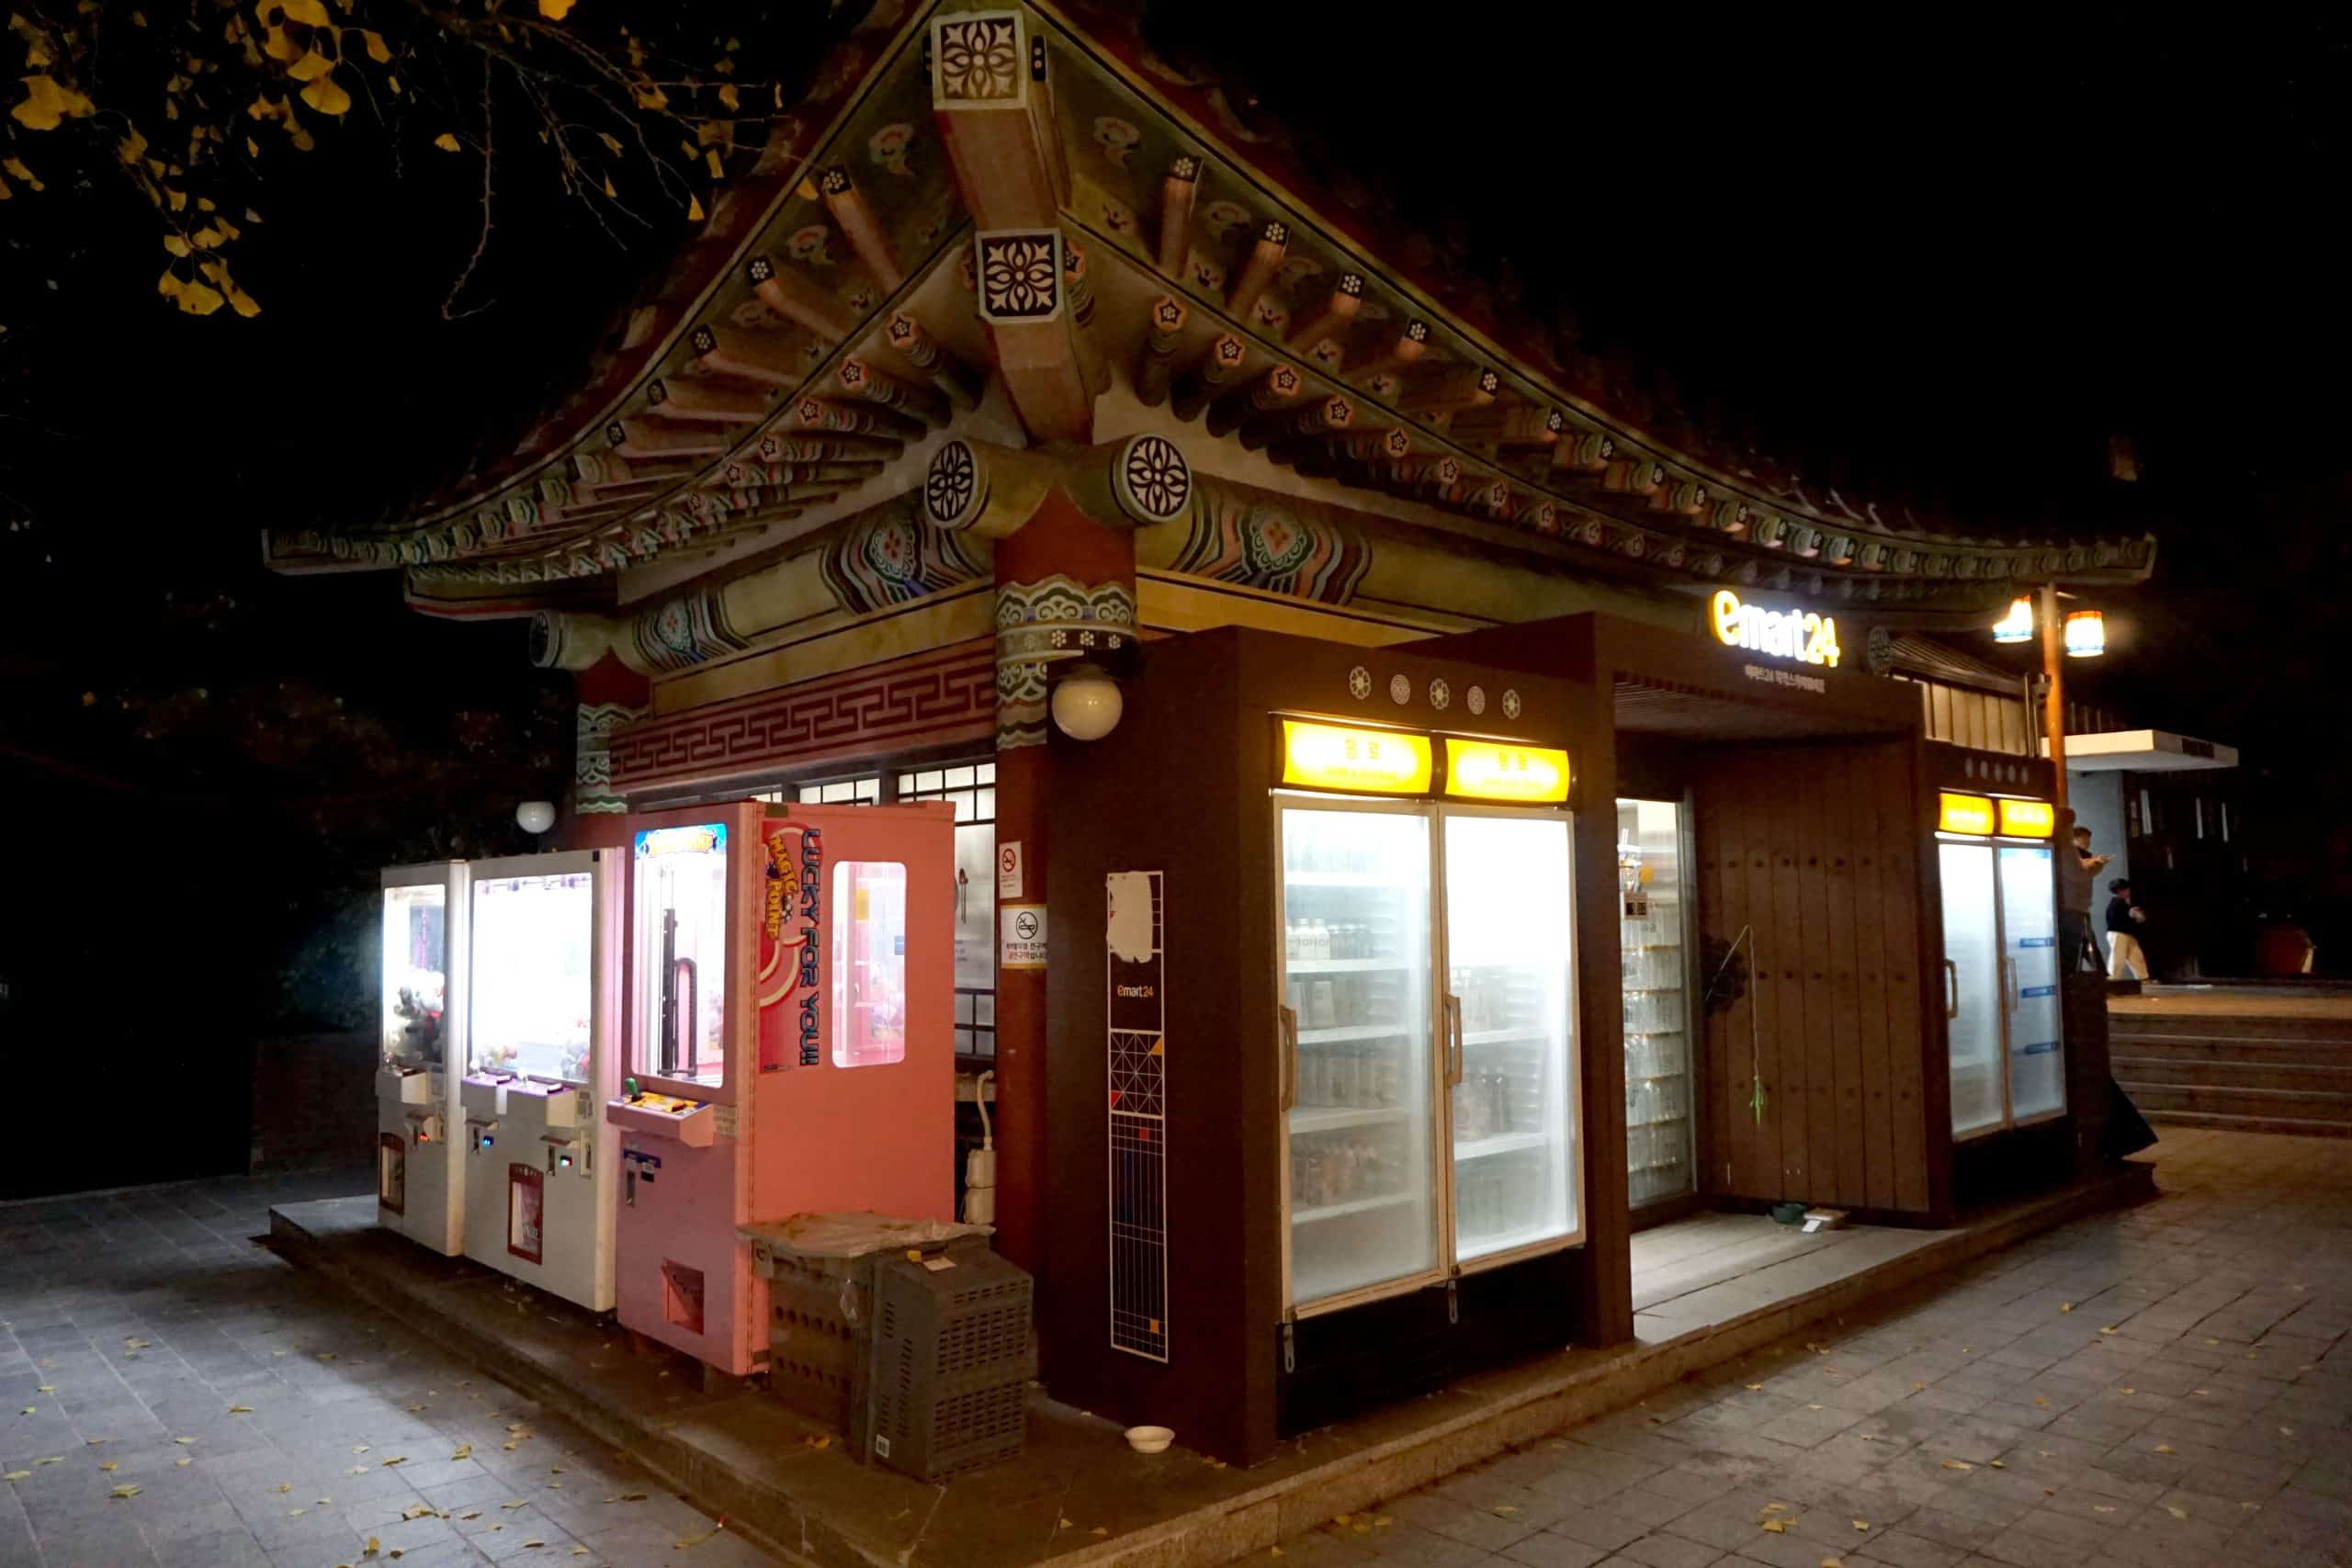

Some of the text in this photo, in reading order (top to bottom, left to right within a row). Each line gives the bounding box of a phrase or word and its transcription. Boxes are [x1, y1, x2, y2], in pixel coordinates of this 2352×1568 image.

[768, 835, 798, 895] MAGIC
[801, 829, 820, 924] LUCKY
[765, 879, 783, 942] POINT
[800, 927, 820, 987] FOR
[1117, 985, 1154, 998] emart24
